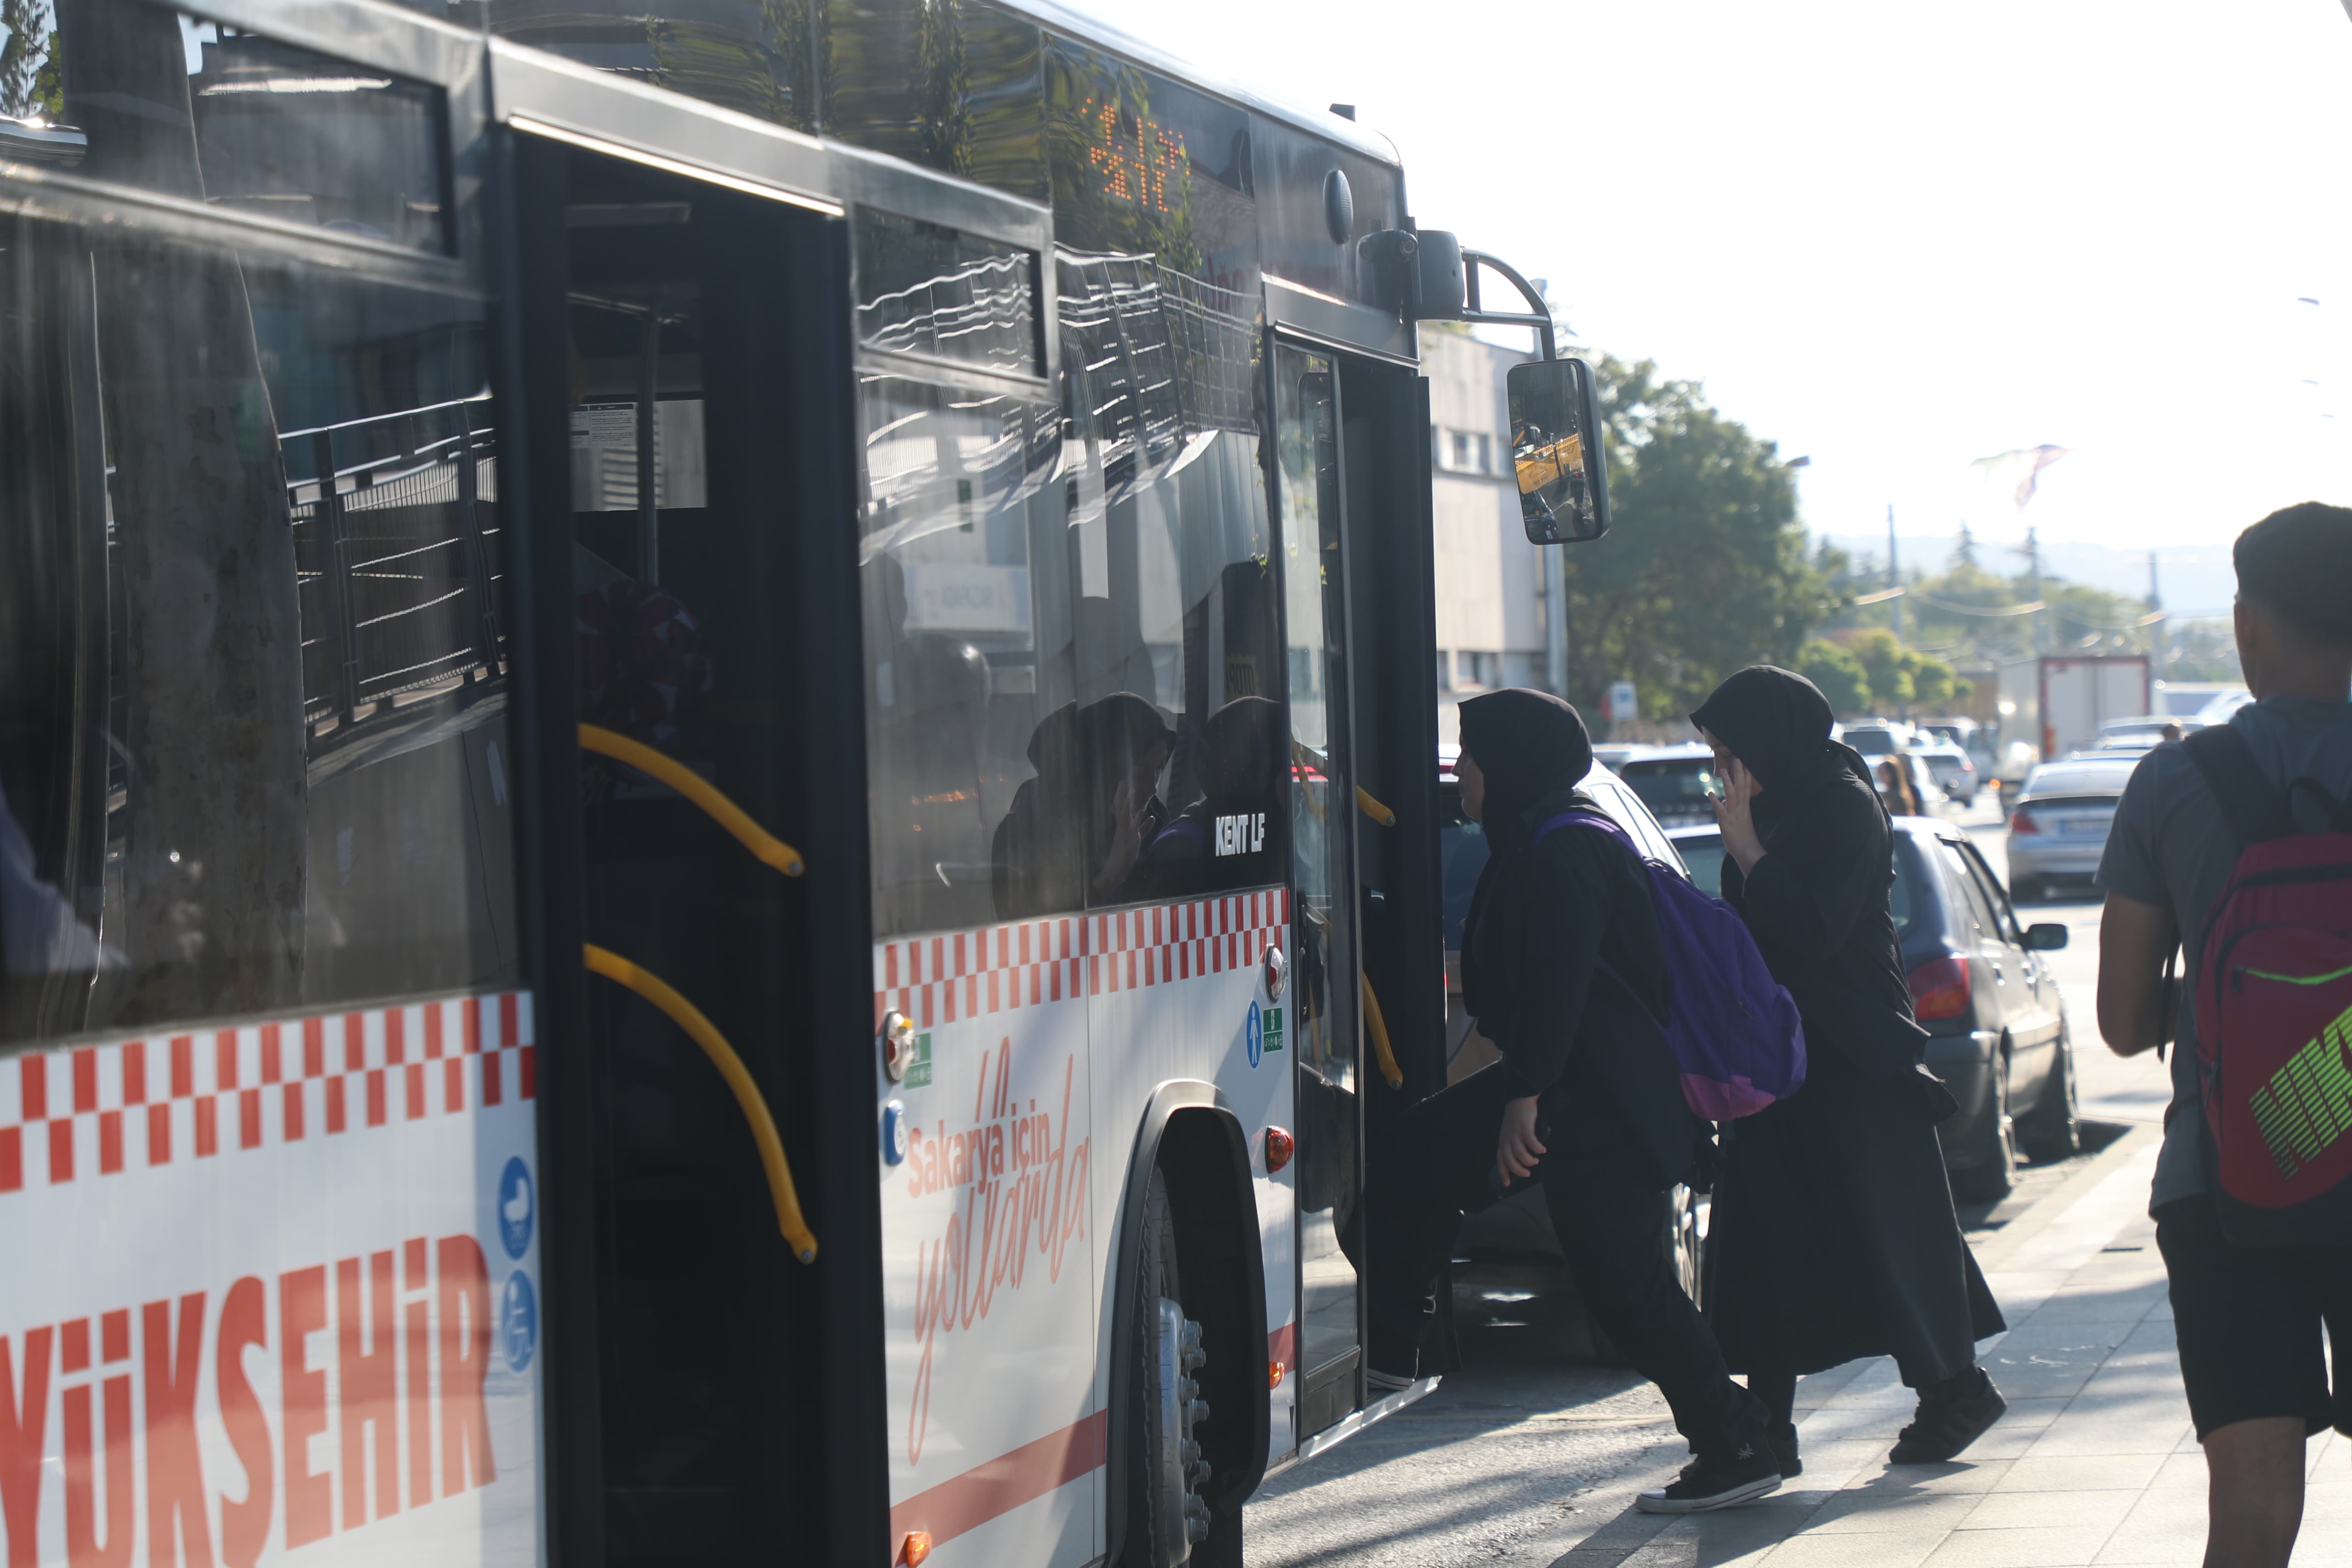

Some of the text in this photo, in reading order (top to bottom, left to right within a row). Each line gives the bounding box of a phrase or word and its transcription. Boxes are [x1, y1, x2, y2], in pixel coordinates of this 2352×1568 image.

[1216, 813, 1265, 856] KENT LF
[2249, 1003, 2352, 1180] NIK
[908, 1099, 1050, 1198] Sakarya için
